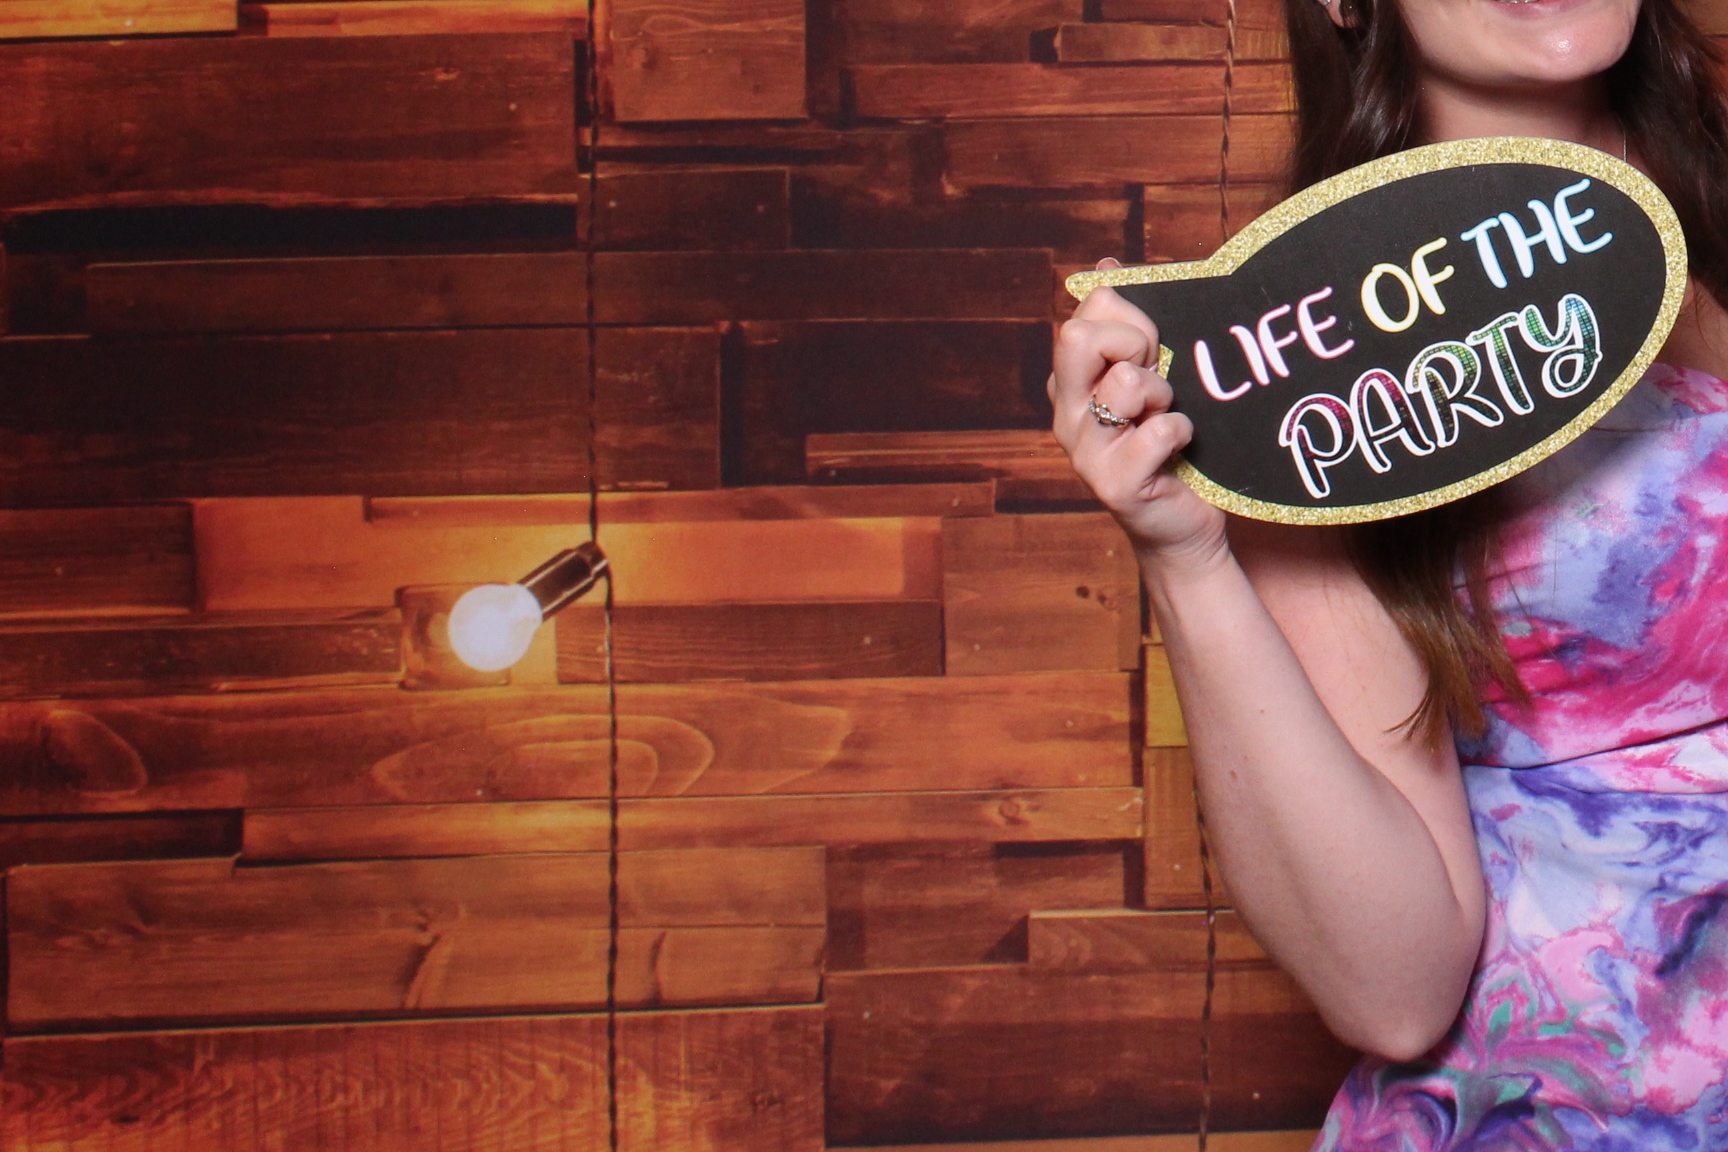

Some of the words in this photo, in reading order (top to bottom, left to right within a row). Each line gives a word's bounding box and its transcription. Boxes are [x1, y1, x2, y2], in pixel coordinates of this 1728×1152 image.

[1193, 286, 1355, 402] LIFE
[1361, 237, 1454, 332] OF
[1460, 178, 1613, 288] THE
[1278, 293, 1603, 499] PARTY
